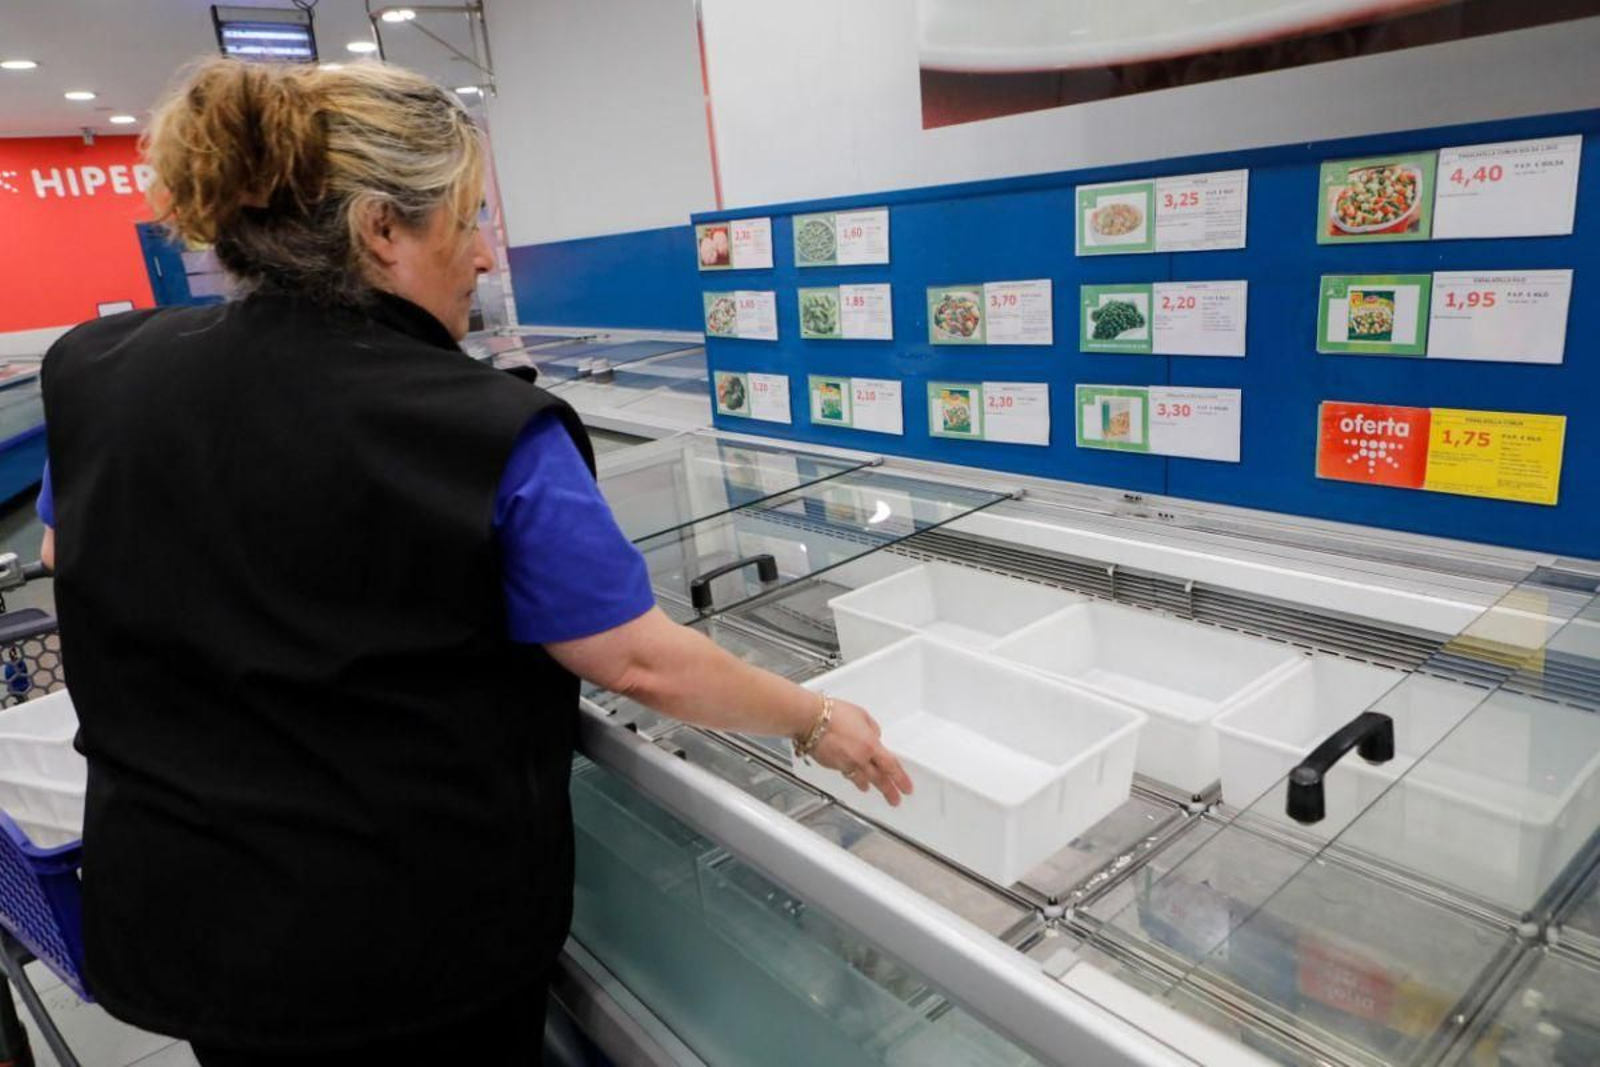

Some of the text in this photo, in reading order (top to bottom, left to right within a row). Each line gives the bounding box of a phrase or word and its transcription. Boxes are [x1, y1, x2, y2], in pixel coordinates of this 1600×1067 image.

[1450, 165, 1503, 187] 4,40
[1164, 191, 1199, 209] 3,25
[991, 295, 1017, 309] 3,70
[1162, 296, 1196, 312] 2,20
[1445, 291, 1496, 310] 1,95
[989, 396, 1013, 409] 2,30
[1157, 403, 1191, 418] 3,30
[1340, 413, 1410, 438] oferta
[1443, 430, 1491, 448] 1,75
